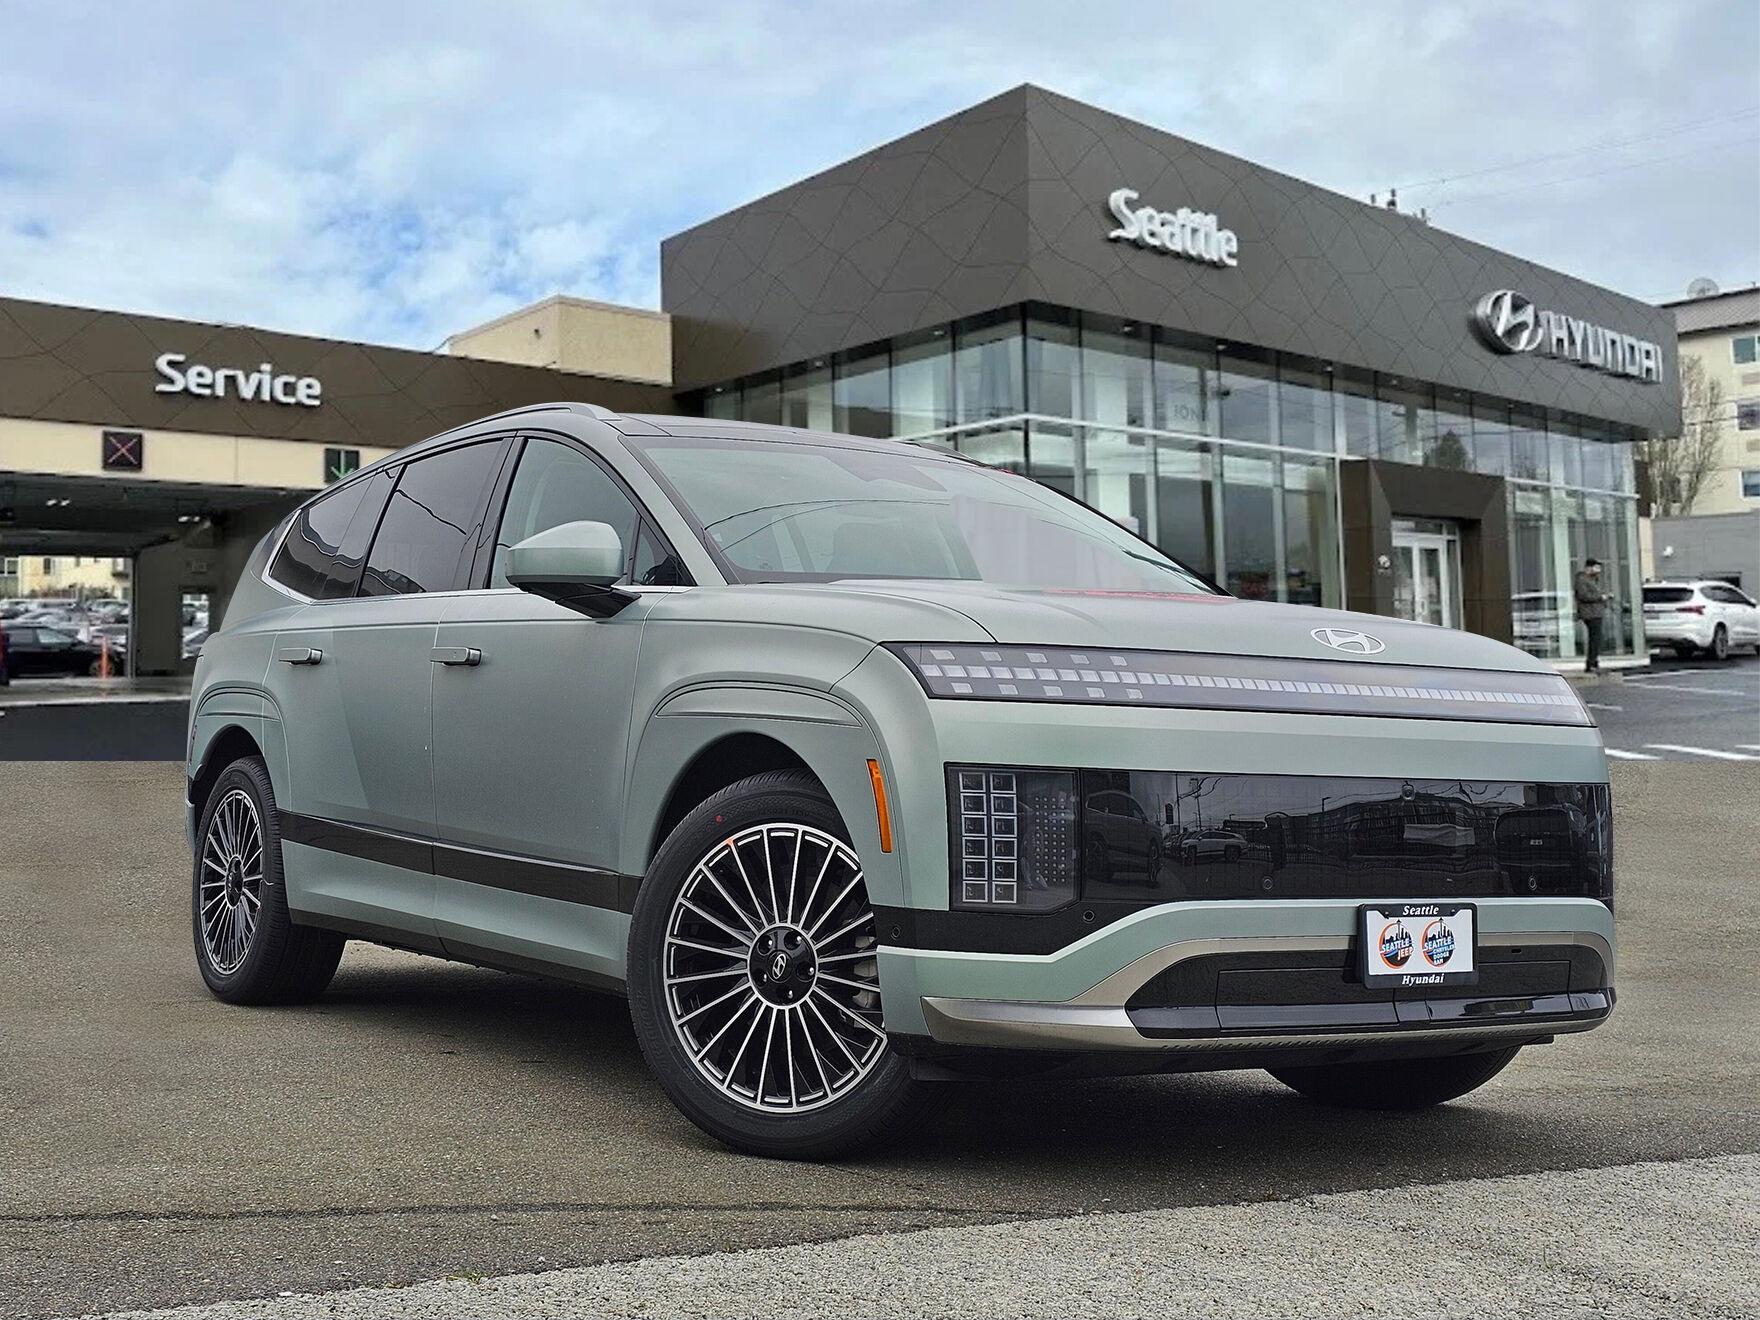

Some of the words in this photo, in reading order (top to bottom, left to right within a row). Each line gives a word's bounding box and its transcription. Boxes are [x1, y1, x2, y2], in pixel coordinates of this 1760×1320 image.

[1109, 188, 1238, 267] Seattle
[1542, 310, 1663, 383] HYUNDAI
[155, 352, 322, 406] Service
[1402, 905, 1440, 916] Seattle
[1381, 938, 1410, 952] SEATTLE
[1424, 936, 1452, 950] SEATTLE
[1398, 946, 1414, 960] JEEP
[1402, 973, 1444, 987] Hyundai
